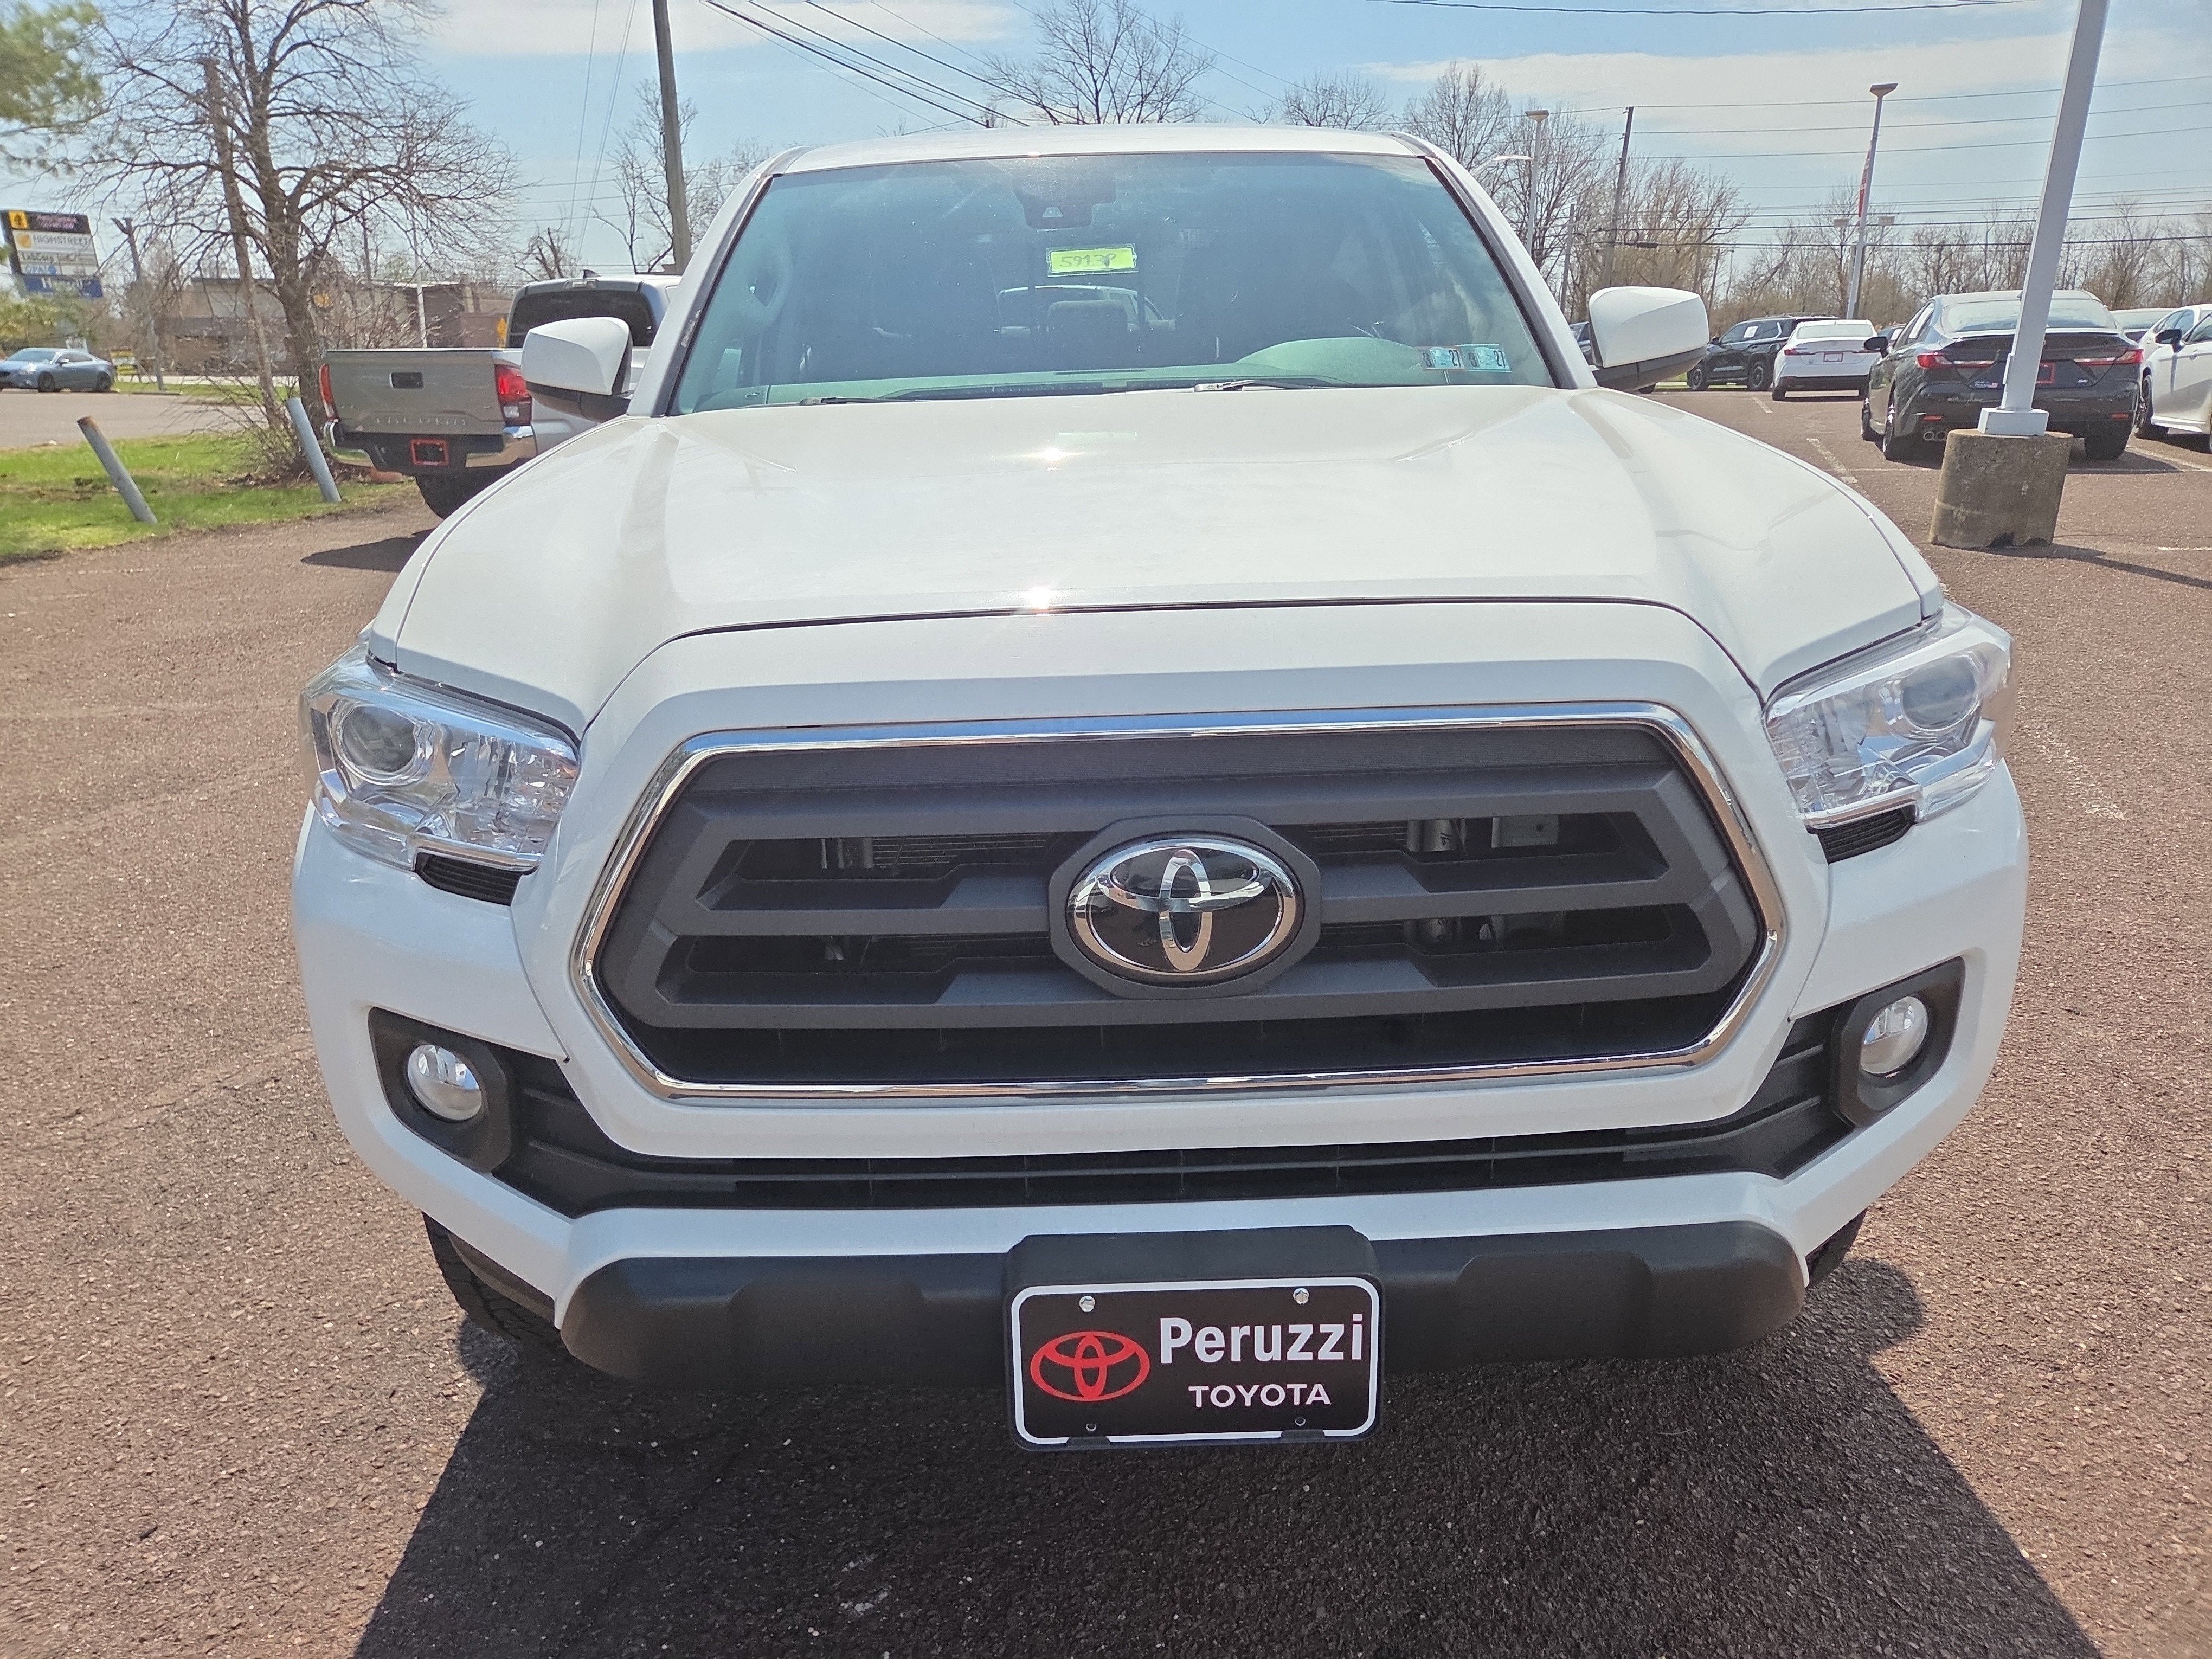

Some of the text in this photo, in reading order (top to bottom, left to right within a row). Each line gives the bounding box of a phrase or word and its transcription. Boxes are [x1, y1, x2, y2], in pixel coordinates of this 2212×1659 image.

[1448, 350, 1462, 368] 27
[1493, 350, 1506, 368] 27
[1160, 1314, 1362, 1364] Peruzzi
[1188, 1384, 1331, 1407] TOYOTA
